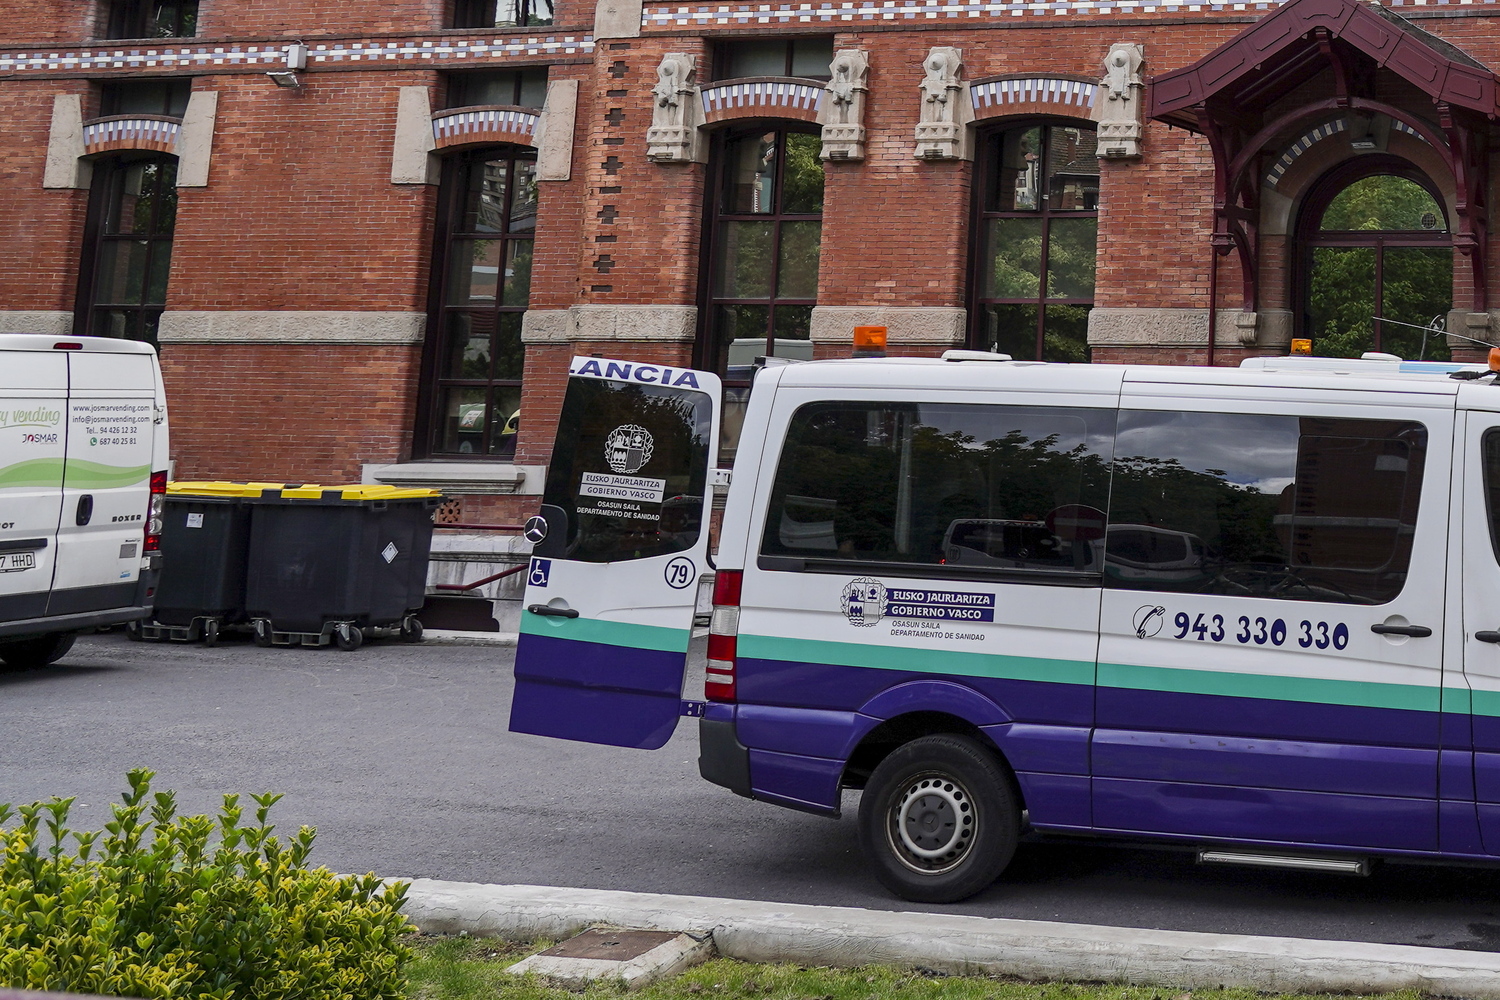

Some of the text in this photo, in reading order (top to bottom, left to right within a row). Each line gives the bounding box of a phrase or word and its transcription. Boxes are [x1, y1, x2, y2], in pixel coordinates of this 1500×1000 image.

[570, 360, 700, 389] ANCIA
[73, 404, 150, 413] www.josmarvending.com
[13, 406, 61, 426] vending
[72, 415, 150, 424] info@josmarvending.com
[100, 426, 108, 434] 94
[108, 426, 120, 434] 426
[121, 426, 129, 434] 12
[129, 426, 138, 434] 32
[120, 437, 128, 445] 25
[129, 437, 137, 445] 81
[585, 474, 660, 488] EUSKO JAURLARITZA
[587, 486, 656, 499] GOBIERNO VASCO
[597, 500, 641, 511] OSASUN SAILA
[112, 514, 142, 523] BOXER
[576, 506, 623, 517] DEPARTAMENTO
[633, 512, 660, 521] SANIDAD
[11, 554, 33, 567] HHD
[670, 564, 688, 584] 79
[893, 590, 990, 605] EUSKO JAURLARITZA
[891, 605, 982, 619] GOBIERNO VASCO
[892, 620, 941, 629] OSASUN SAILA
[1173, 611, 1349, 651] 943 330 330
[890, 629, 943, 639] DEPARTAMENTO
[955, 633, 985, 641] SANIDAD
